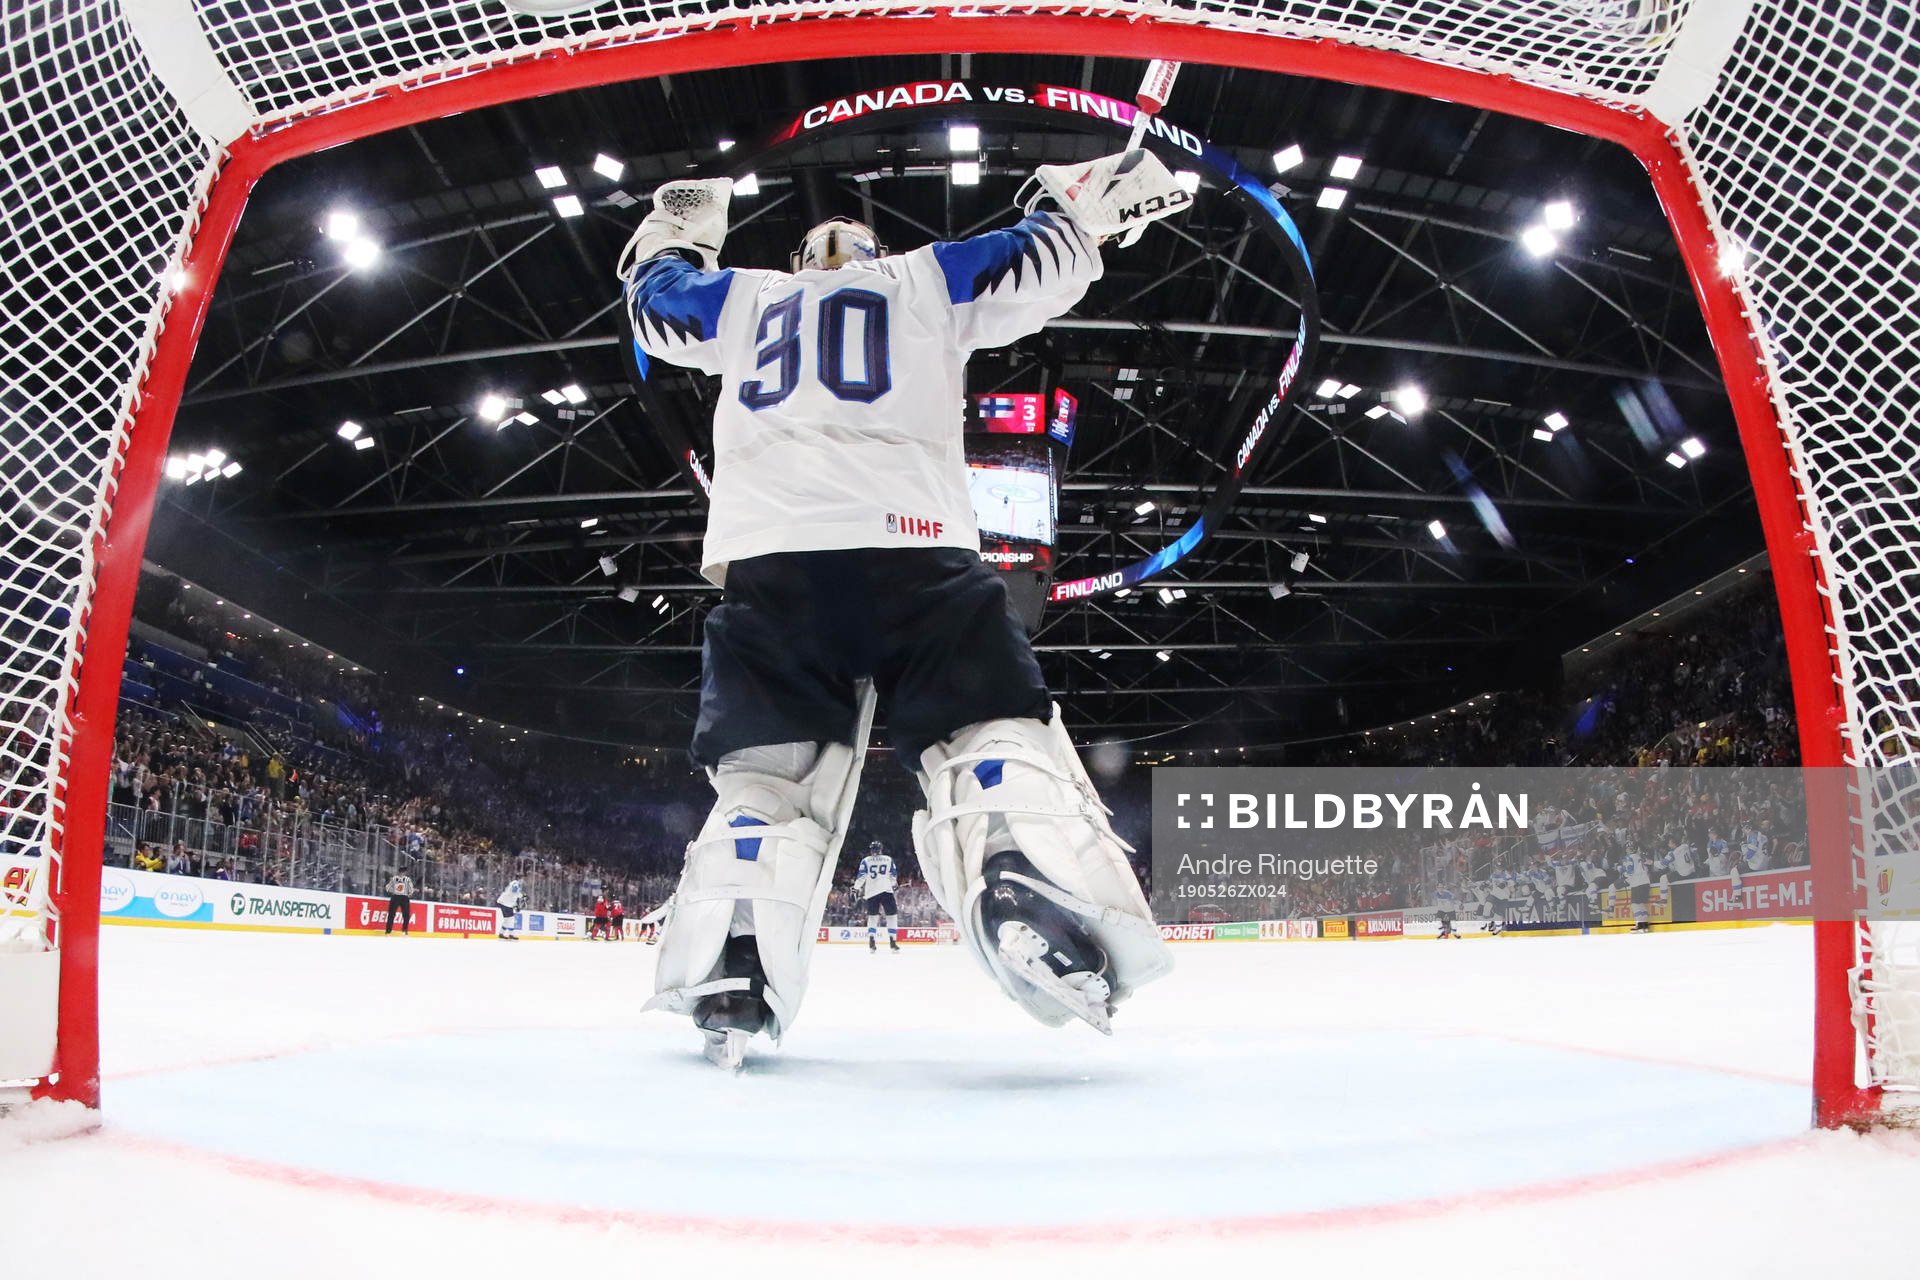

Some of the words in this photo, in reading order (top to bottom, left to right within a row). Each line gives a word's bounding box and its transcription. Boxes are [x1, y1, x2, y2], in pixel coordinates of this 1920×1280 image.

[803, 81, 972, 130] CANADA
[983, 87, 1035, 104] vs.
[1119, 189, 1190, 223] CCM
[738, 287, 892, 412] 30
[1237, 407, 1270, 469] CANADA
[1279, 313, 1306, 396] FINLAND
[1023, 405, 1036, 421] 3
[690, 449, 712, 498] CANAD
[900, 515, 944, 539] IIHF
[980, 551, 1034, 563] PIONSHIP
[1056, 571, 1124, 600] FINLAND
[249, 897, 332, 919] TRANSPETROL
[1701, 880, 1813, 913] SHTE-M.P
[371, 910, 416, 925] BEZIA
[438, 917, 492, 931] #BRATISLAVA
[1161, 926, 1215, 940] ФОНБЕТ
